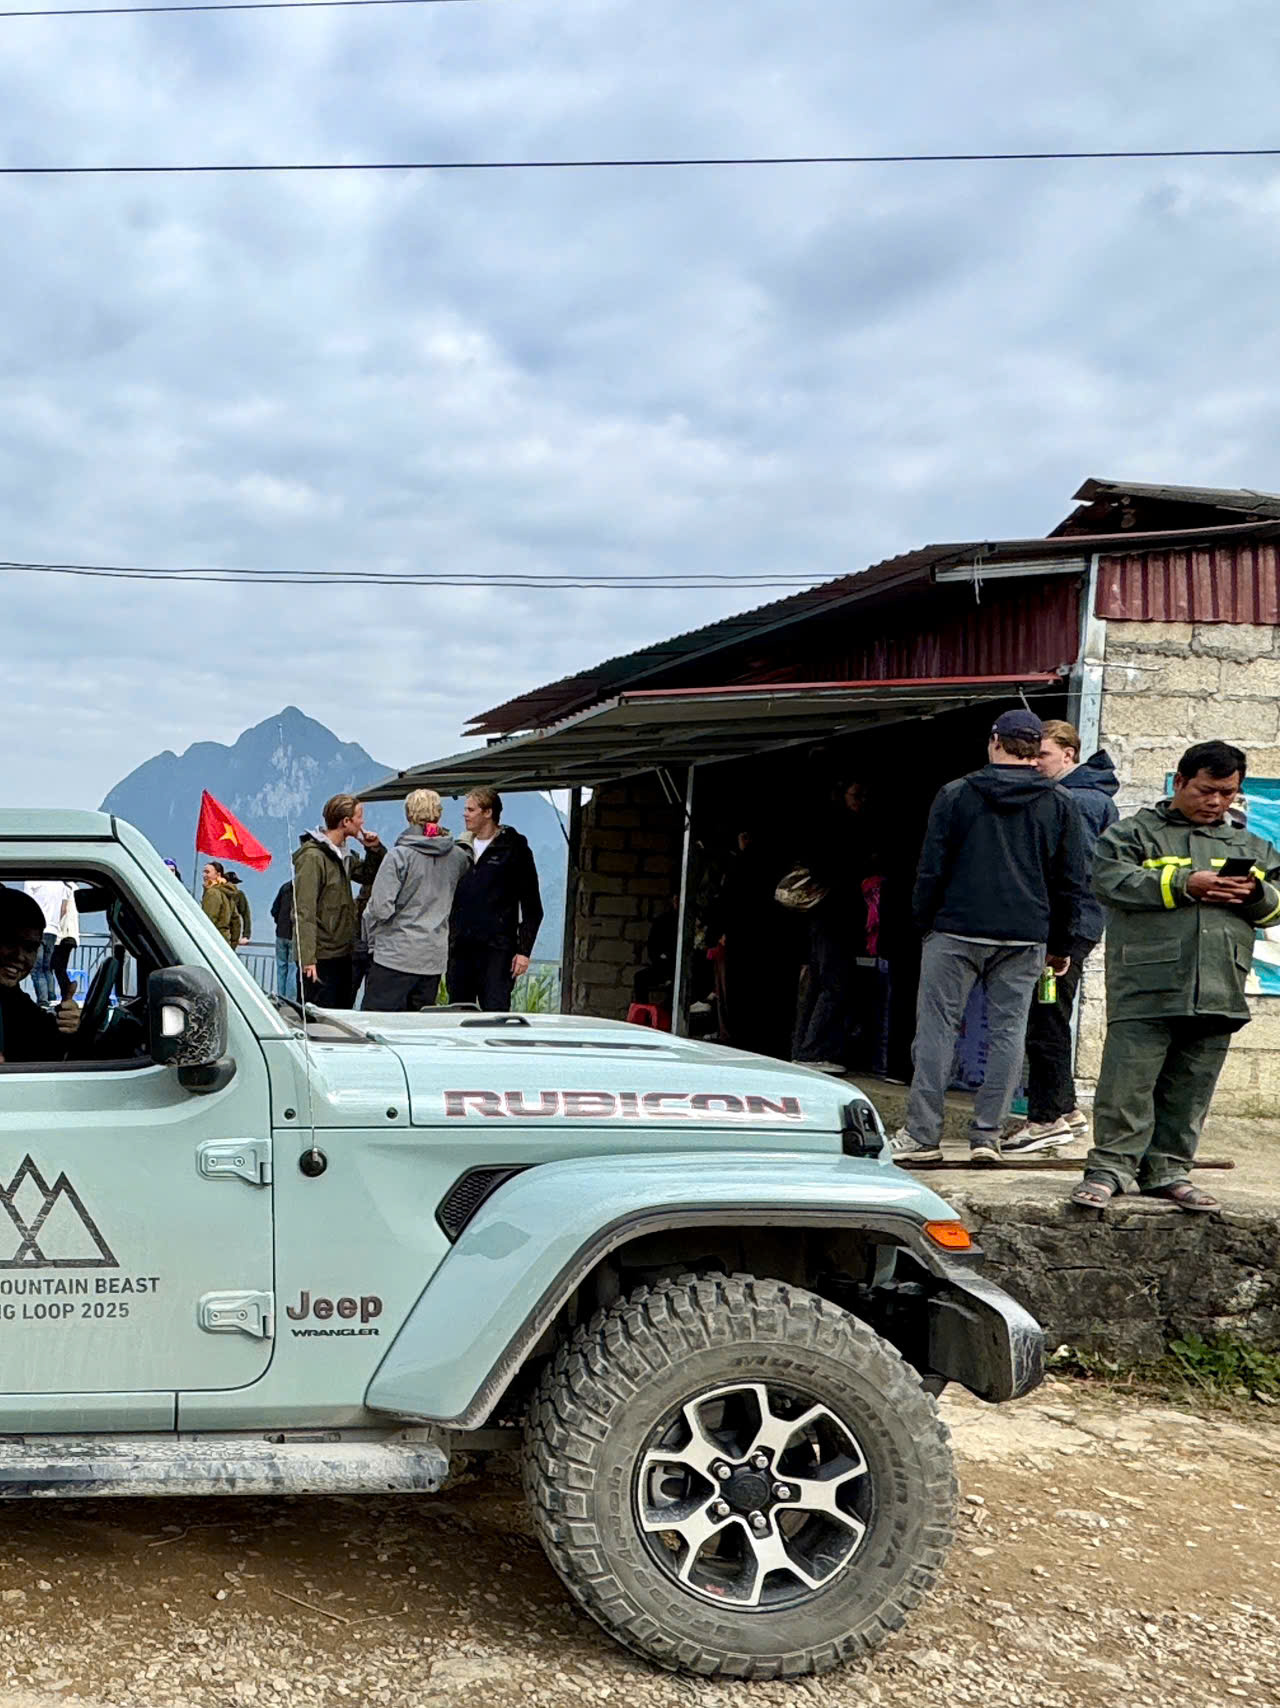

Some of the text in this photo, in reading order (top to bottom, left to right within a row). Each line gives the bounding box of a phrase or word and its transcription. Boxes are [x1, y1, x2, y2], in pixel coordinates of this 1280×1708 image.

[443, 1091, 804, 1119] RUBICON
[95, 1277, 160, 1294] BEAST
[23, 1303, 75, 1319] LOOP
[81, 1302, 130, 1318] 2025
[286, 1290, 383, 1324] Jeep
[291, 1328, 380, 1337] WRANGLER
